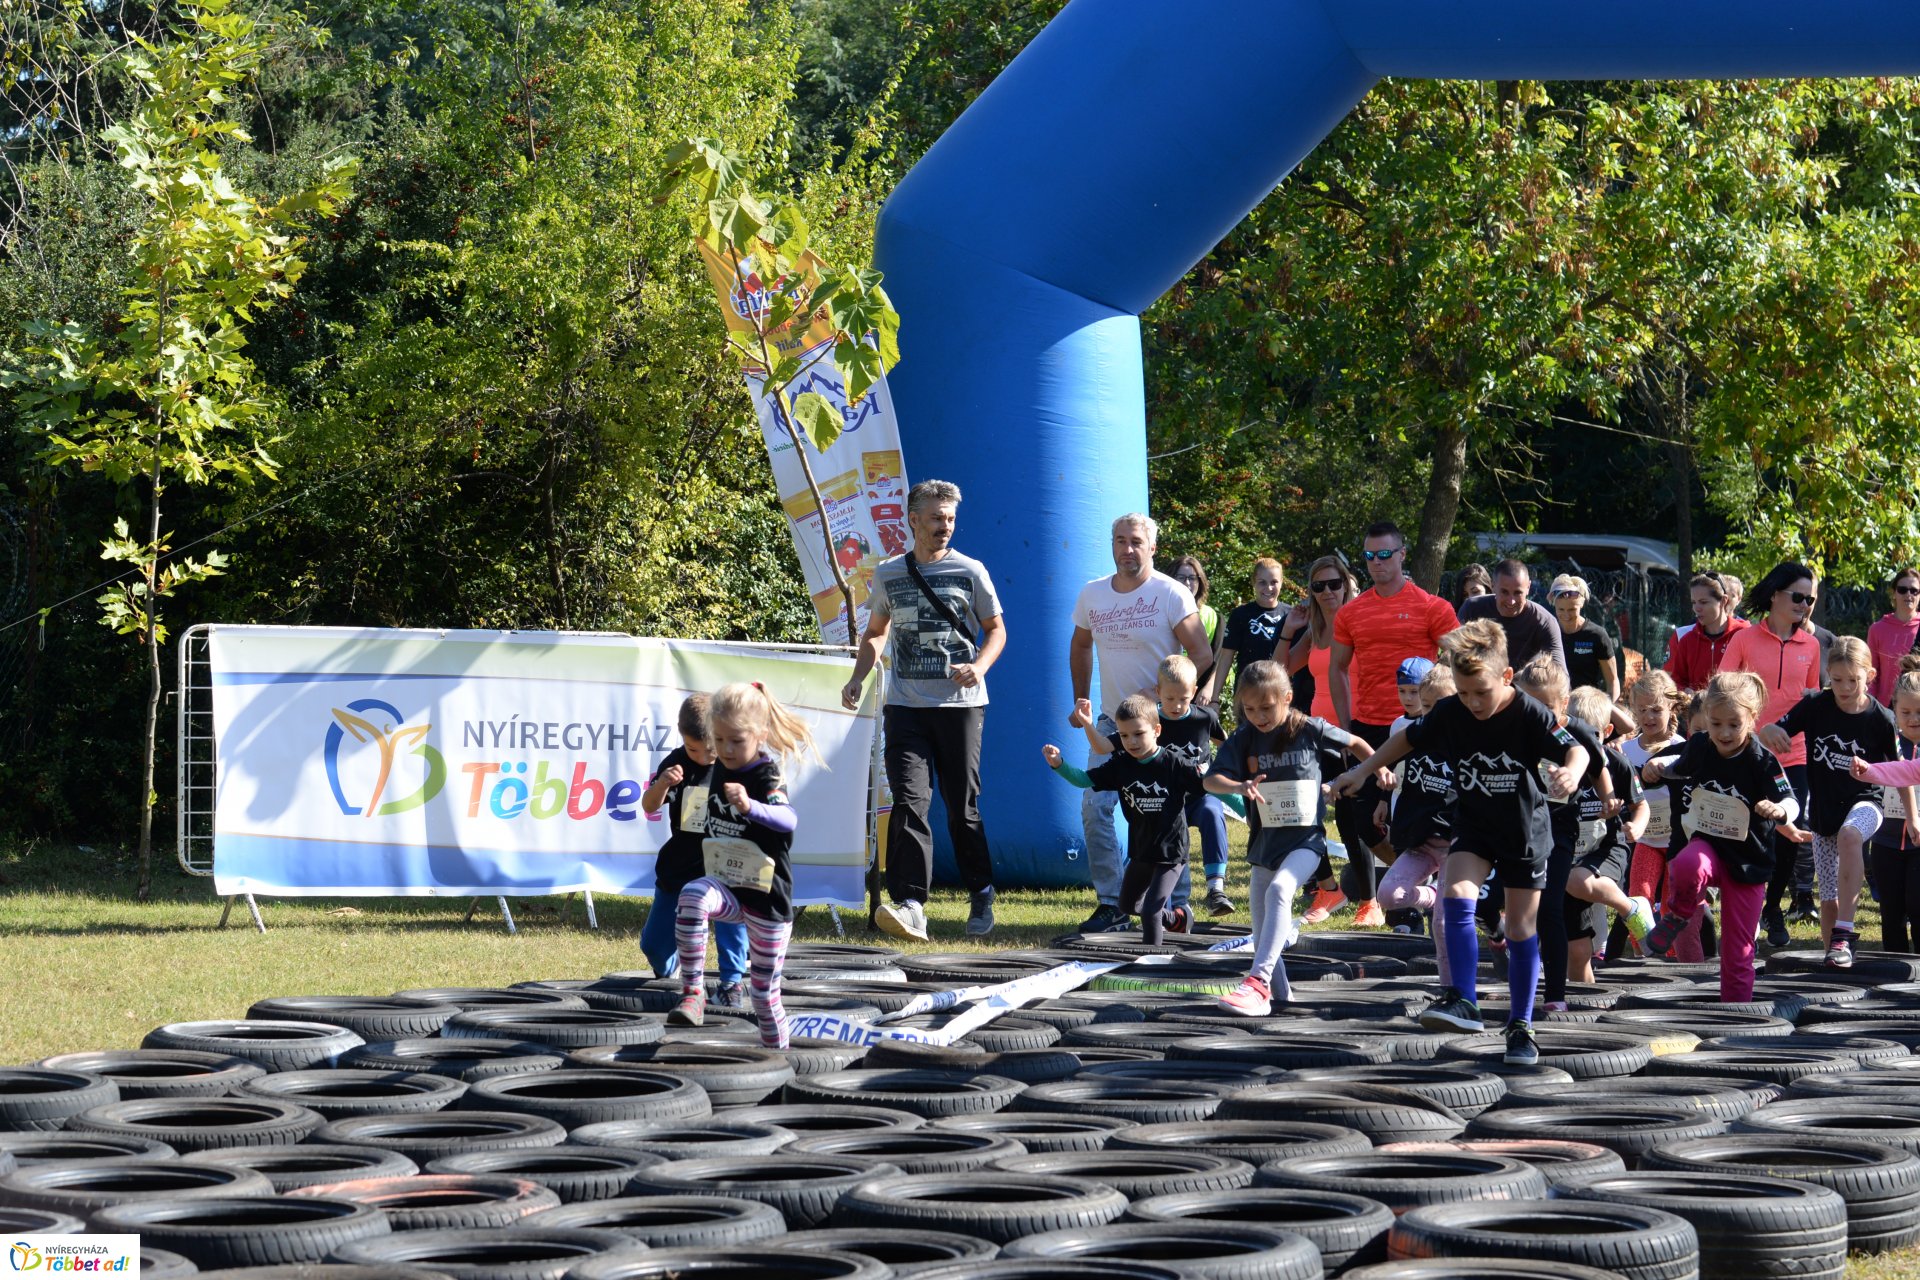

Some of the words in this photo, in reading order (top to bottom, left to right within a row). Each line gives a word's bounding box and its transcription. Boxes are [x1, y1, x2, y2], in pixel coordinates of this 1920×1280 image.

[1089, 597, 1159, 623] Handcrafted
[1096, 624, 1119, 633] RETRO
[1120, 618, 1143, 631] JEANS
[463, 714, 673, 751] NYÍREGYHÁZ
[1778, 784, 1791, 793] HU
[1280, 800, 1296, 809] 083
[1710, 810, 1724, 820] 010
[726, 858, 744, 869] 032
[789, 1016, 882, 1048] TREME
